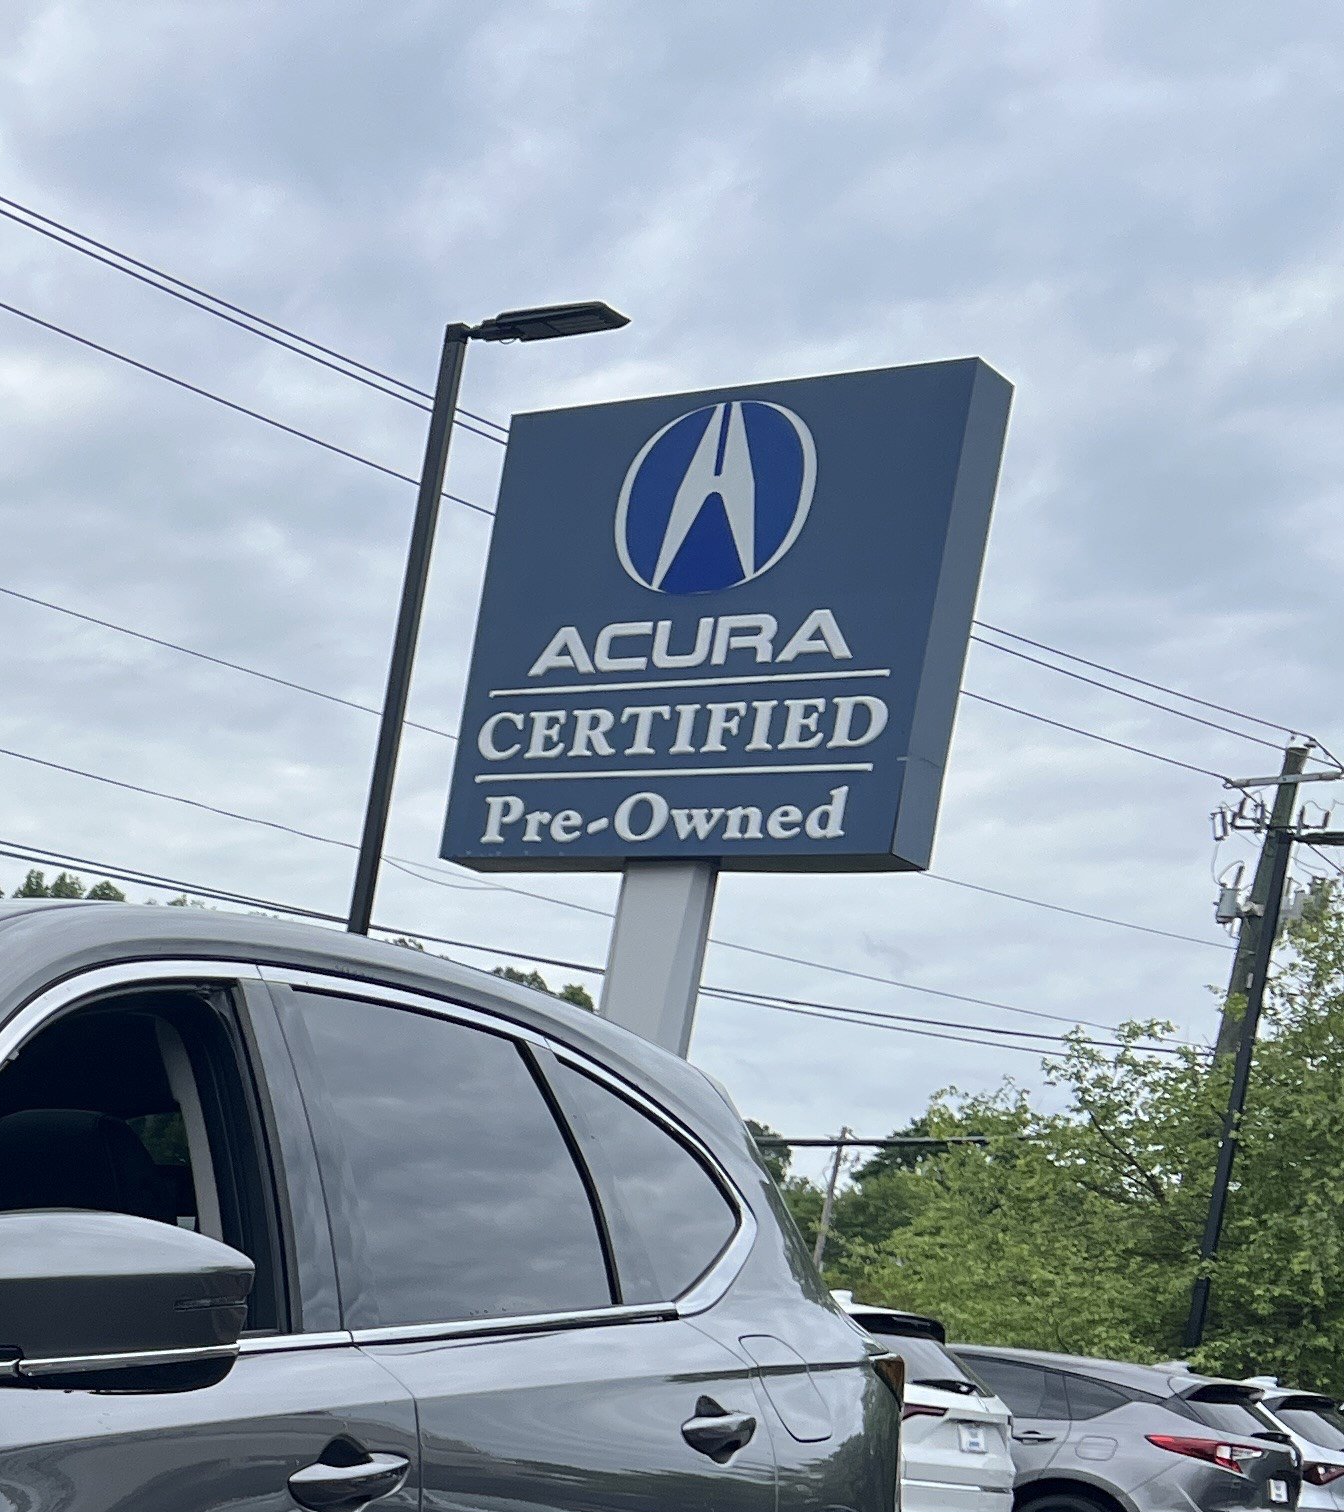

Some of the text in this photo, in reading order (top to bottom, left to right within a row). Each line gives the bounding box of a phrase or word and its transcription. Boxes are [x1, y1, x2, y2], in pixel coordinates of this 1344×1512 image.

[527, 608, 853, 677] ACURA
[477, 694, 889, 761] CERTIFIED
[479, 785, 850, 844] Pre-Owned
